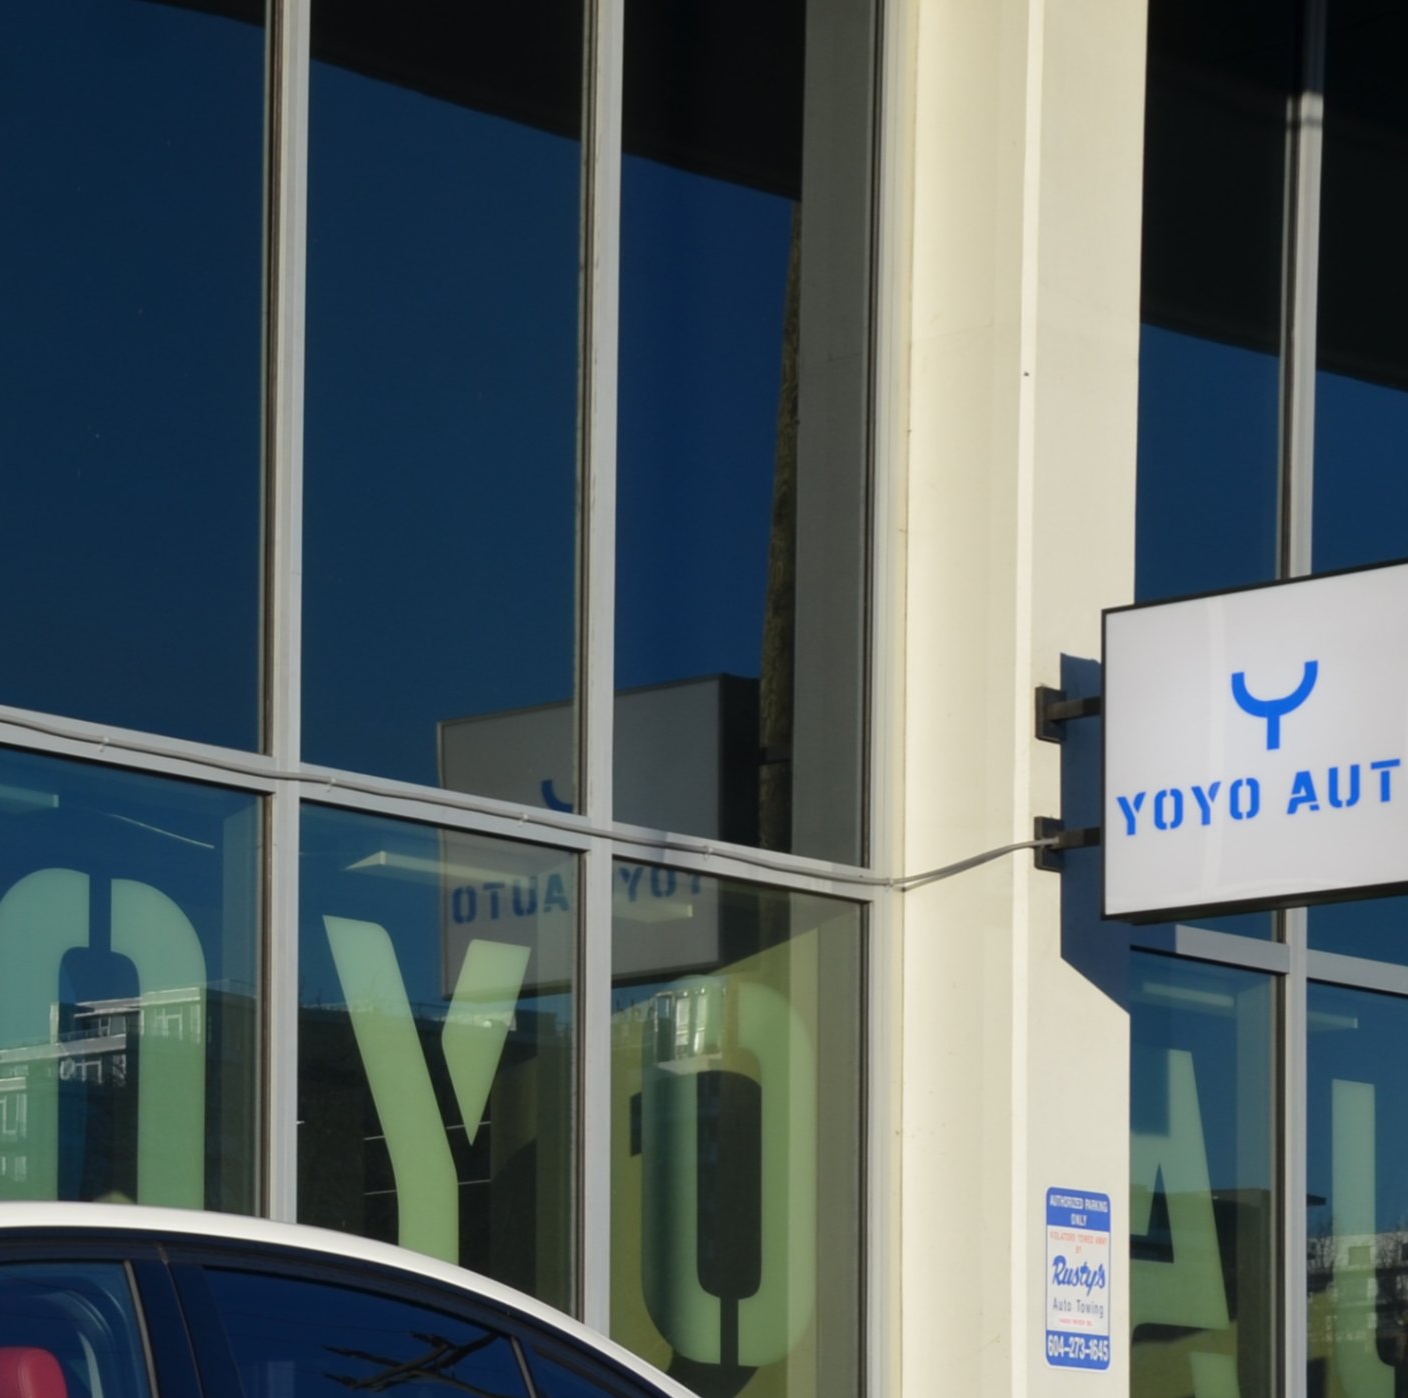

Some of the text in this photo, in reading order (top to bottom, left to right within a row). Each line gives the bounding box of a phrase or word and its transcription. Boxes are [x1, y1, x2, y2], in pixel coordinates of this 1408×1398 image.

[1116, 777, 1261, 836] YOYO
[1052, 1255, 1106, 1296] Rusty's
[1052, 1297, 1104, 1319] Auto Towing
